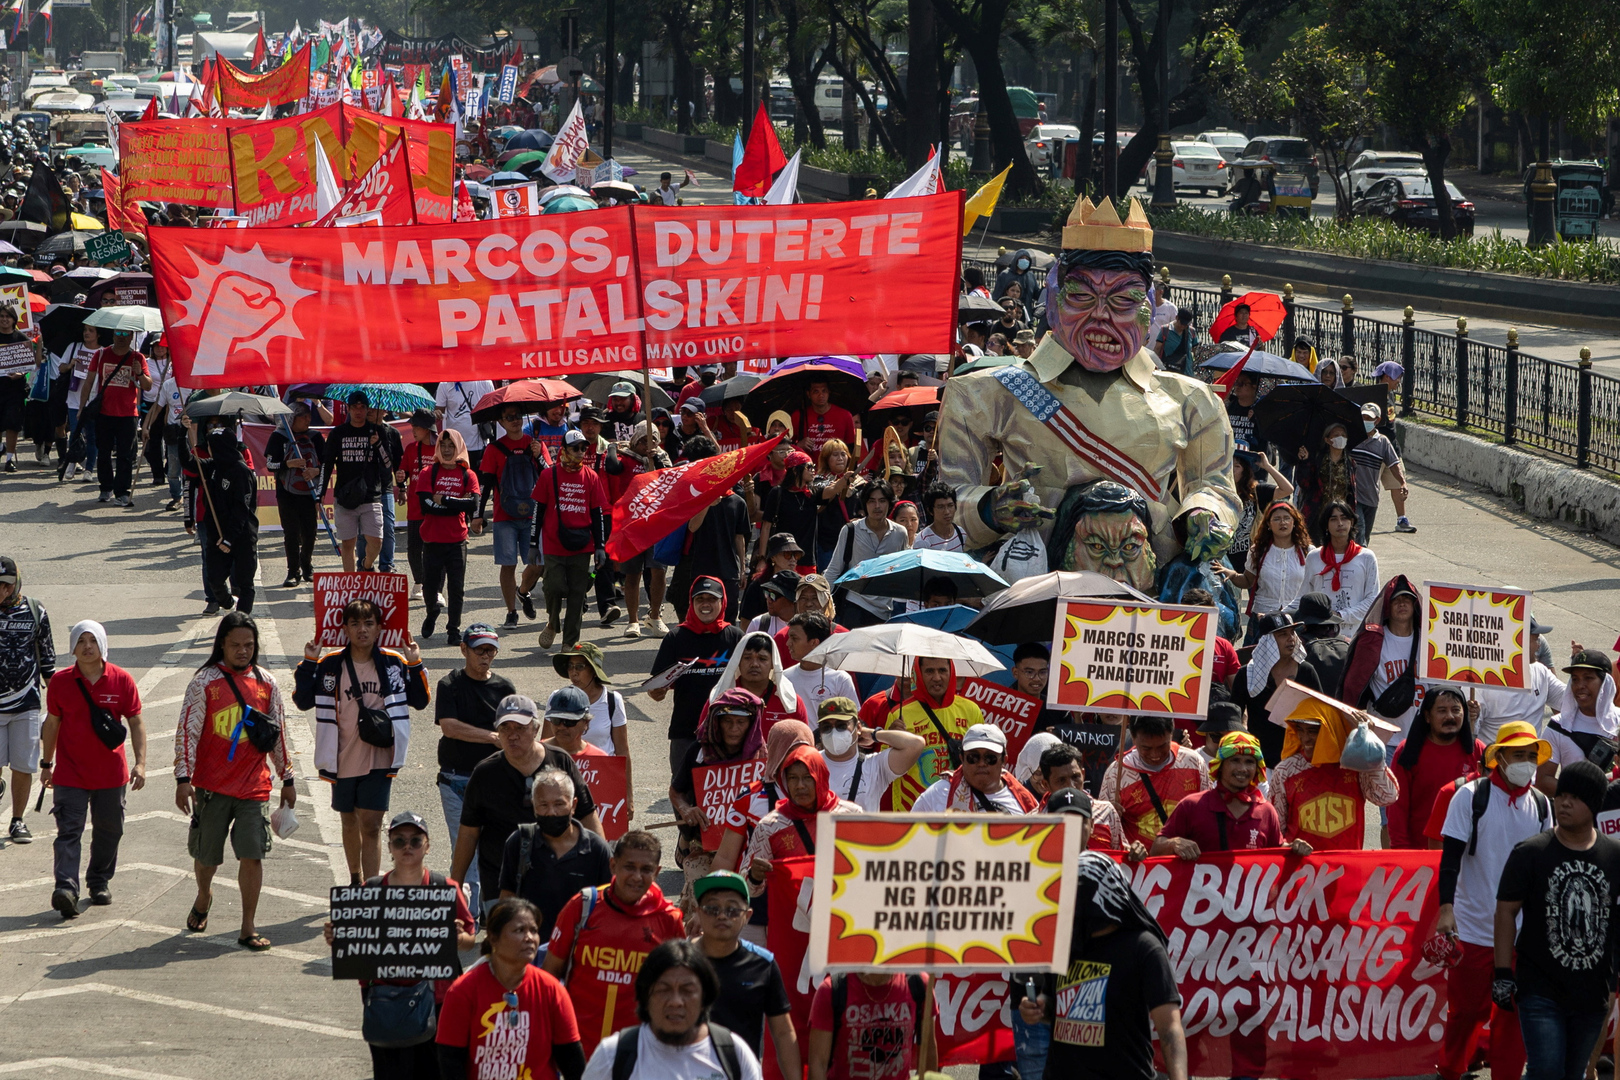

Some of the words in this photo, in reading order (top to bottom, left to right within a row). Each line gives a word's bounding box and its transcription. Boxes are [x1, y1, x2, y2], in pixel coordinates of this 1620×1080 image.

[182, 133, 228, 148] GOBYER
[230, 116, 453, 204] KMU
[240, 200, 285, 227] TUNAY
[91, 240, 128, 260] RESIGN!
[341, 226, 630, 287] MARCOS,
[654, 211, 923, 268] DUTERTE
[437, 273, 824, 349] PATALSIKIN!
[521, 344, 637, 369] KILUSANG
[646, 339, 698, 360] MAYO
[704, 335, 745, 355] UNO
[317, 574, 406, 592] MARCOS-DUTERTE
[8, 621, 33, 630] GARAGE
[1442, 610, 1471, 626] SARA
[1472, 613, 1504, 631] REYNA
[1082, 628, 1145, 649] MARCOS
[1149, 634, 1186, 652] HARI
[1448, 629, 1464, 643] NG
[1466, 630, 1501, 647] KORAP,
[1093, 647, 1114, 663] NG
[1118, 648, 1169, 670] KORAP,
[1445, 642, 1505, 663] PANAGUTIN!
[1086, 663, 1174, 687] PANAGUTIN!
[964, 681, 1036, 718] DUTERTE
[1060, 728, 1115, 747] MATAKOT
[865, 860, 966, 882] MARCOS
[974, 861, 1031, 882] HARI
[1553, 859, 1605, 884] SANTA
[884, 886, 916, 907] NG
[925, 886, 1007, 909] KORAP,
[1180, 863, 1344, 926] BULOK
[1349, 865, 1434, 923] NA
[873, 910, 1014, 932] PANAGUTIN!
[1545, 905, 1560, 917] 13
[1599, 907, 1610, 919] 13
[1424, 934, 1447, 954] FUCK
[1549, 943, 1604, 972] MUERTE
[377, 965, 453, 978] NSMR-ADLO
[597, 970, 632, 985] ADLO
[1074, 979, 1107, 1007] YAN
[845, 1002, 912, 1023] OSAKA
[1069, 1004, 1103, 1021] MGA
[485, 1027, 530, 1048] ITAAS!
[1055, 1020, 1104, 1046] KURAKOT!
[474, 1045, 528, 1065] PRESYO
